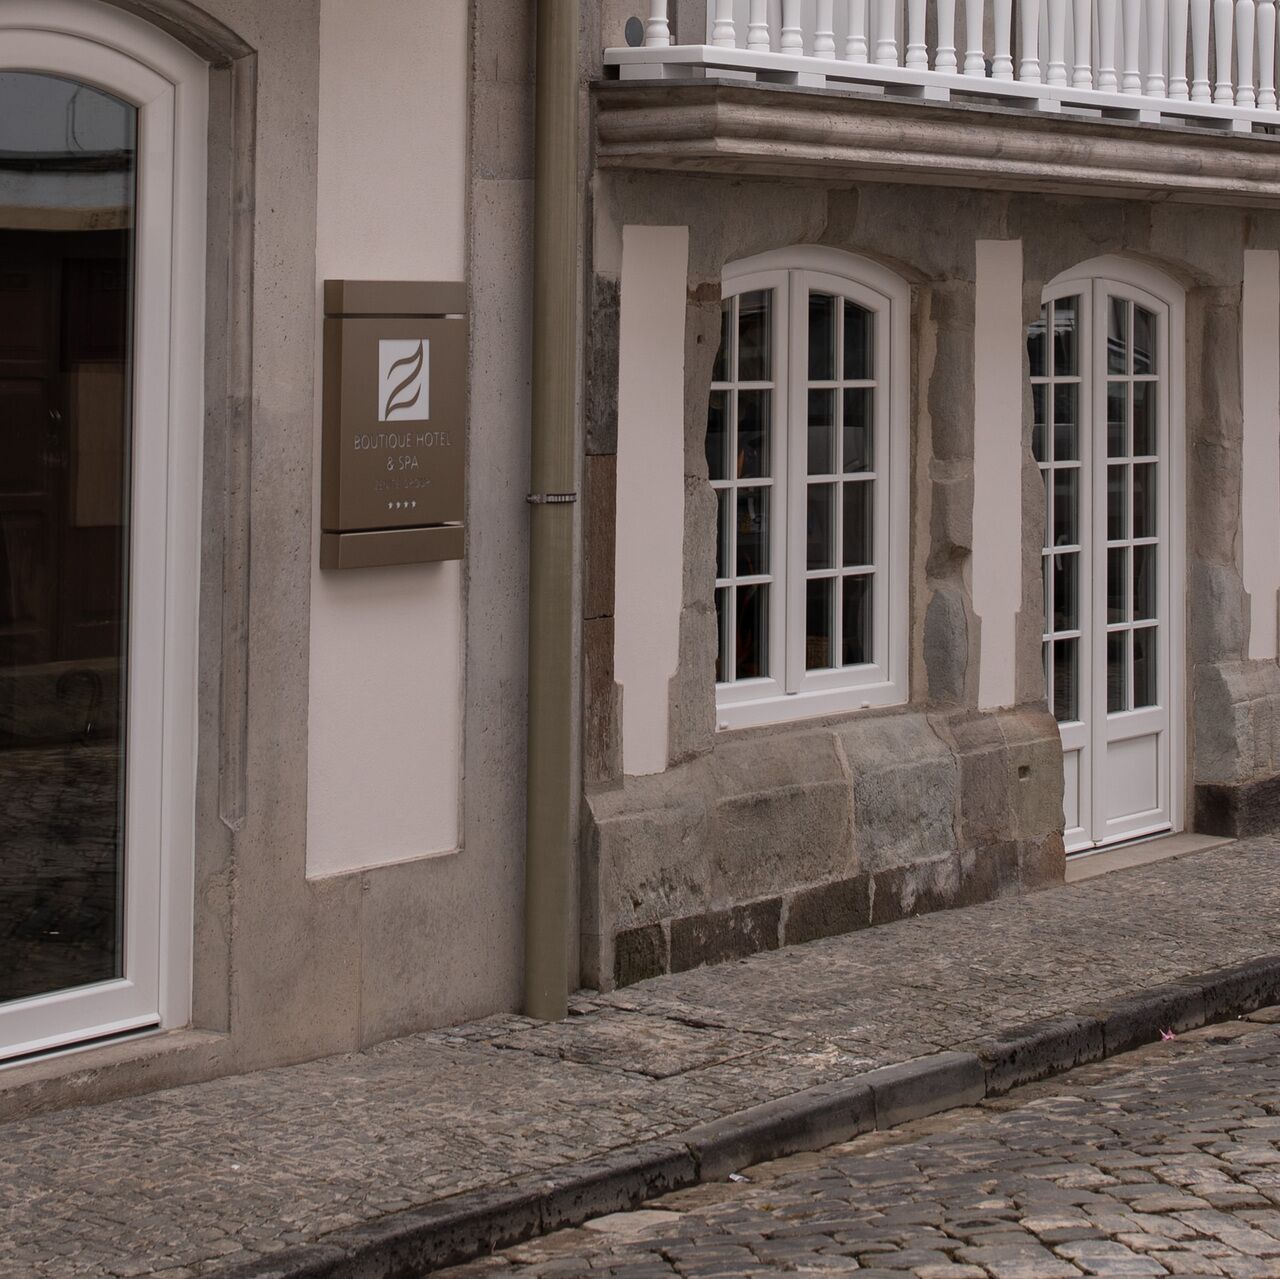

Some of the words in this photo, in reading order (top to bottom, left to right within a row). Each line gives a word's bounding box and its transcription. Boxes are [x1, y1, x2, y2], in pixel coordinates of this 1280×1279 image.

[354, 433, 412, 449] BOUTIQUE
[416, 432, 451, 446] HOTEL
[386, 456, 395, 471] &
[398, 456, 419, 470] SPA
